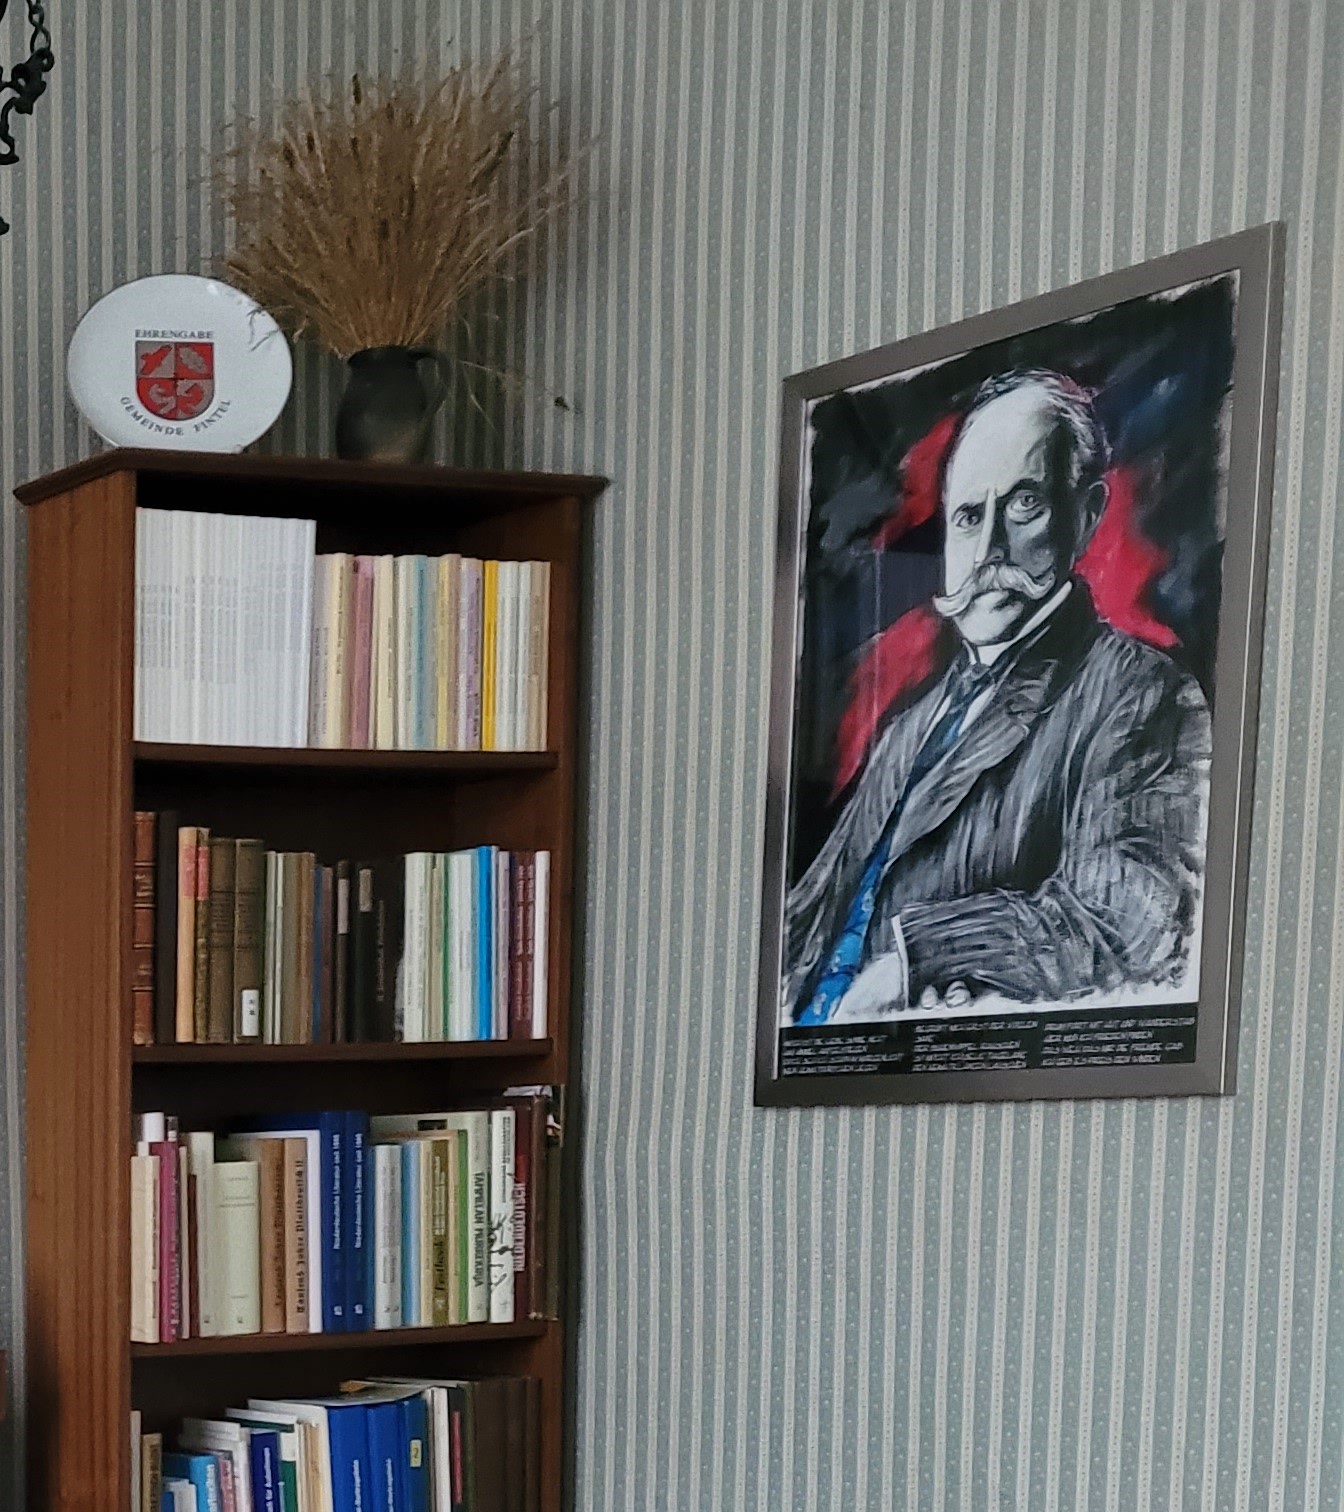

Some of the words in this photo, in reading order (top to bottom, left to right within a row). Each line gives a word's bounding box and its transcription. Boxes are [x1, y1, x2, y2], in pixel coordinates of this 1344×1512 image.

[134, 329, 215, 339] EHRENGABE
[119, 396, 185, 436] GEMEINDE
[193, 400, 232, 433] FINTEL
